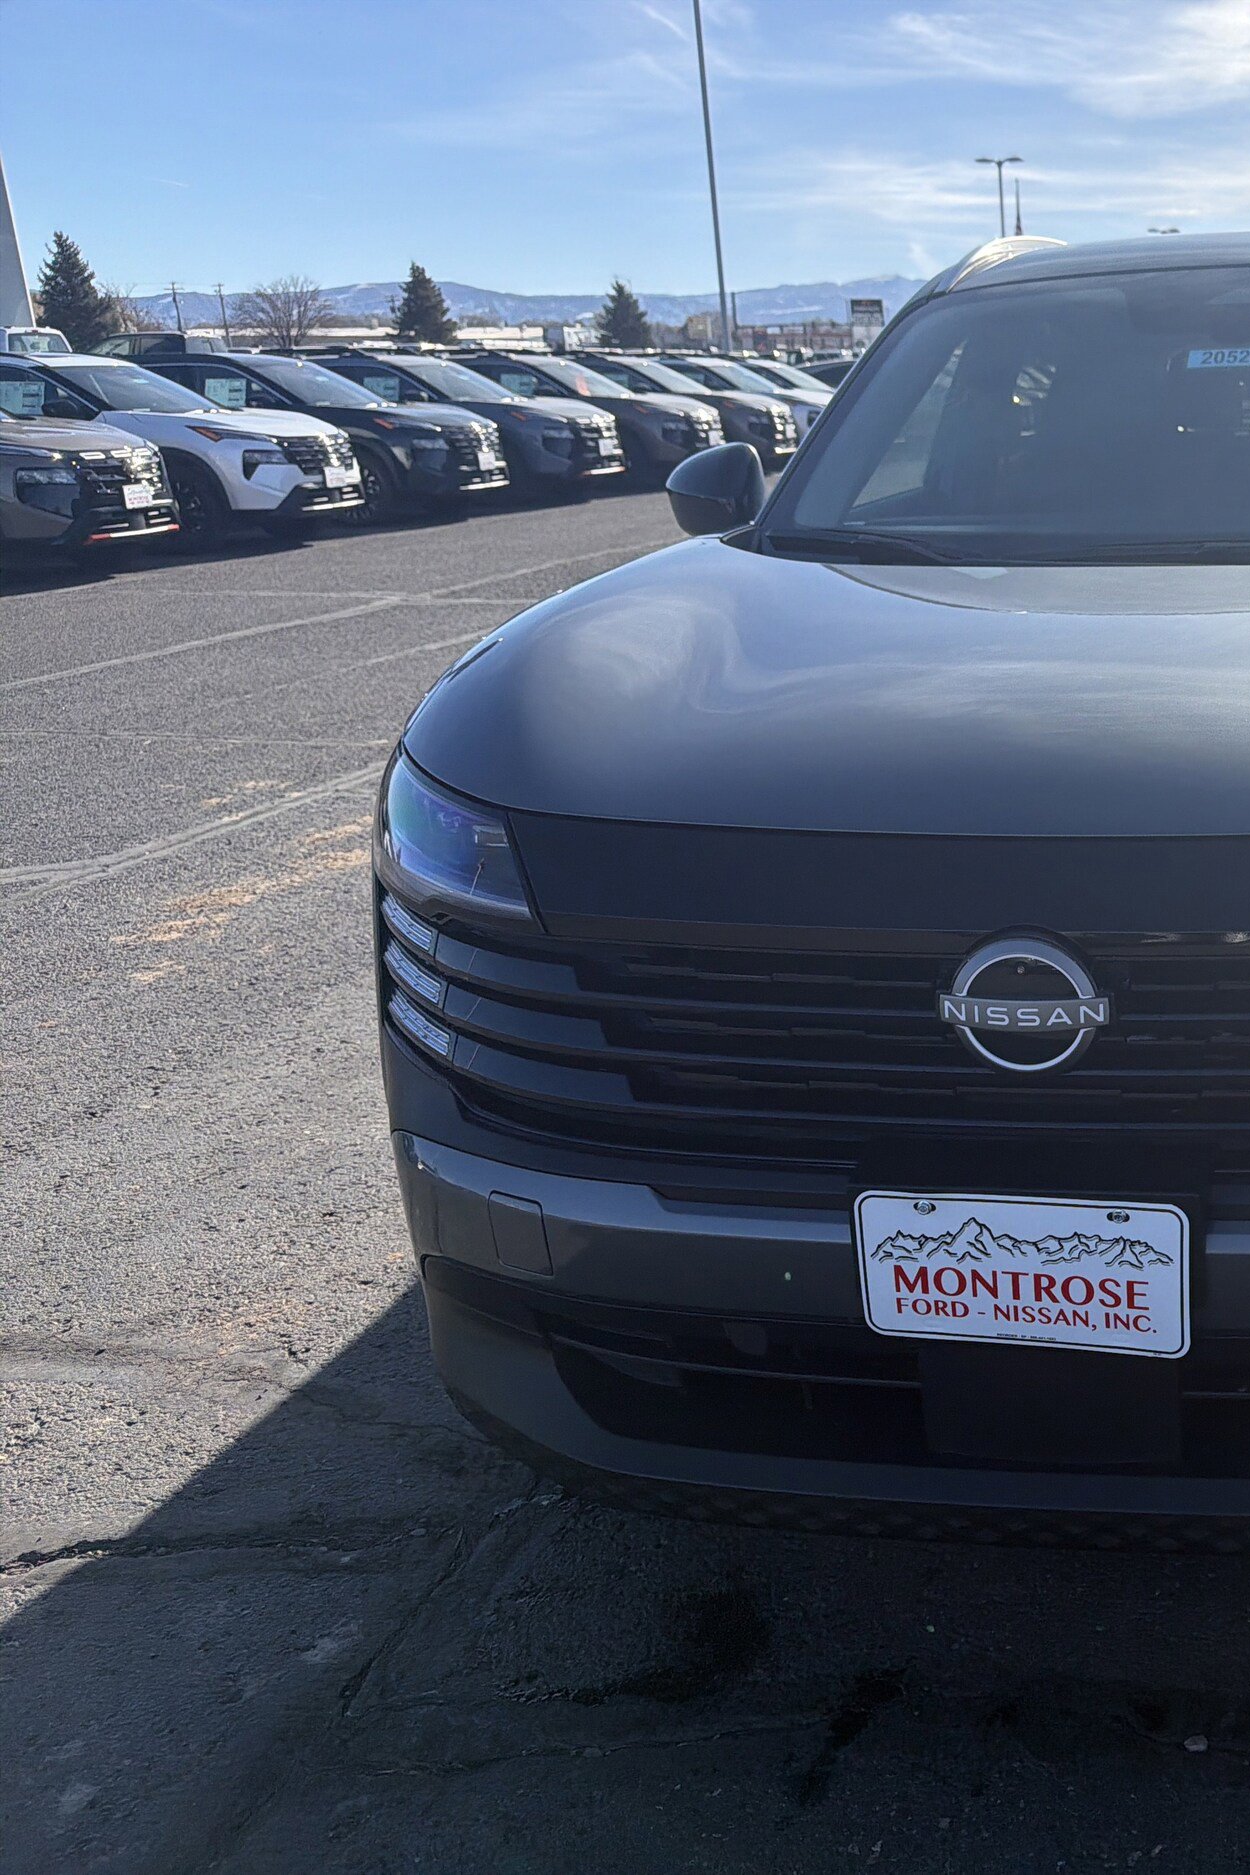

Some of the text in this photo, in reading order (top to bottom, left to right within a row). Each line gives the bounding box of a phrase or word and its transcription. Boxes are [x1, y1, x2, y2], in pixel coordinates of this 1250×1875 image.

[944, 1001, 1104, 1026] NISSAN
[893, 1265, 1150, 1311] MONTROSE
[896, 1298, 970, 1318] FORD
[993, 1304, 1097, 1332] NISSAN,
[1104, 1312, 1157, 1334] INC.
